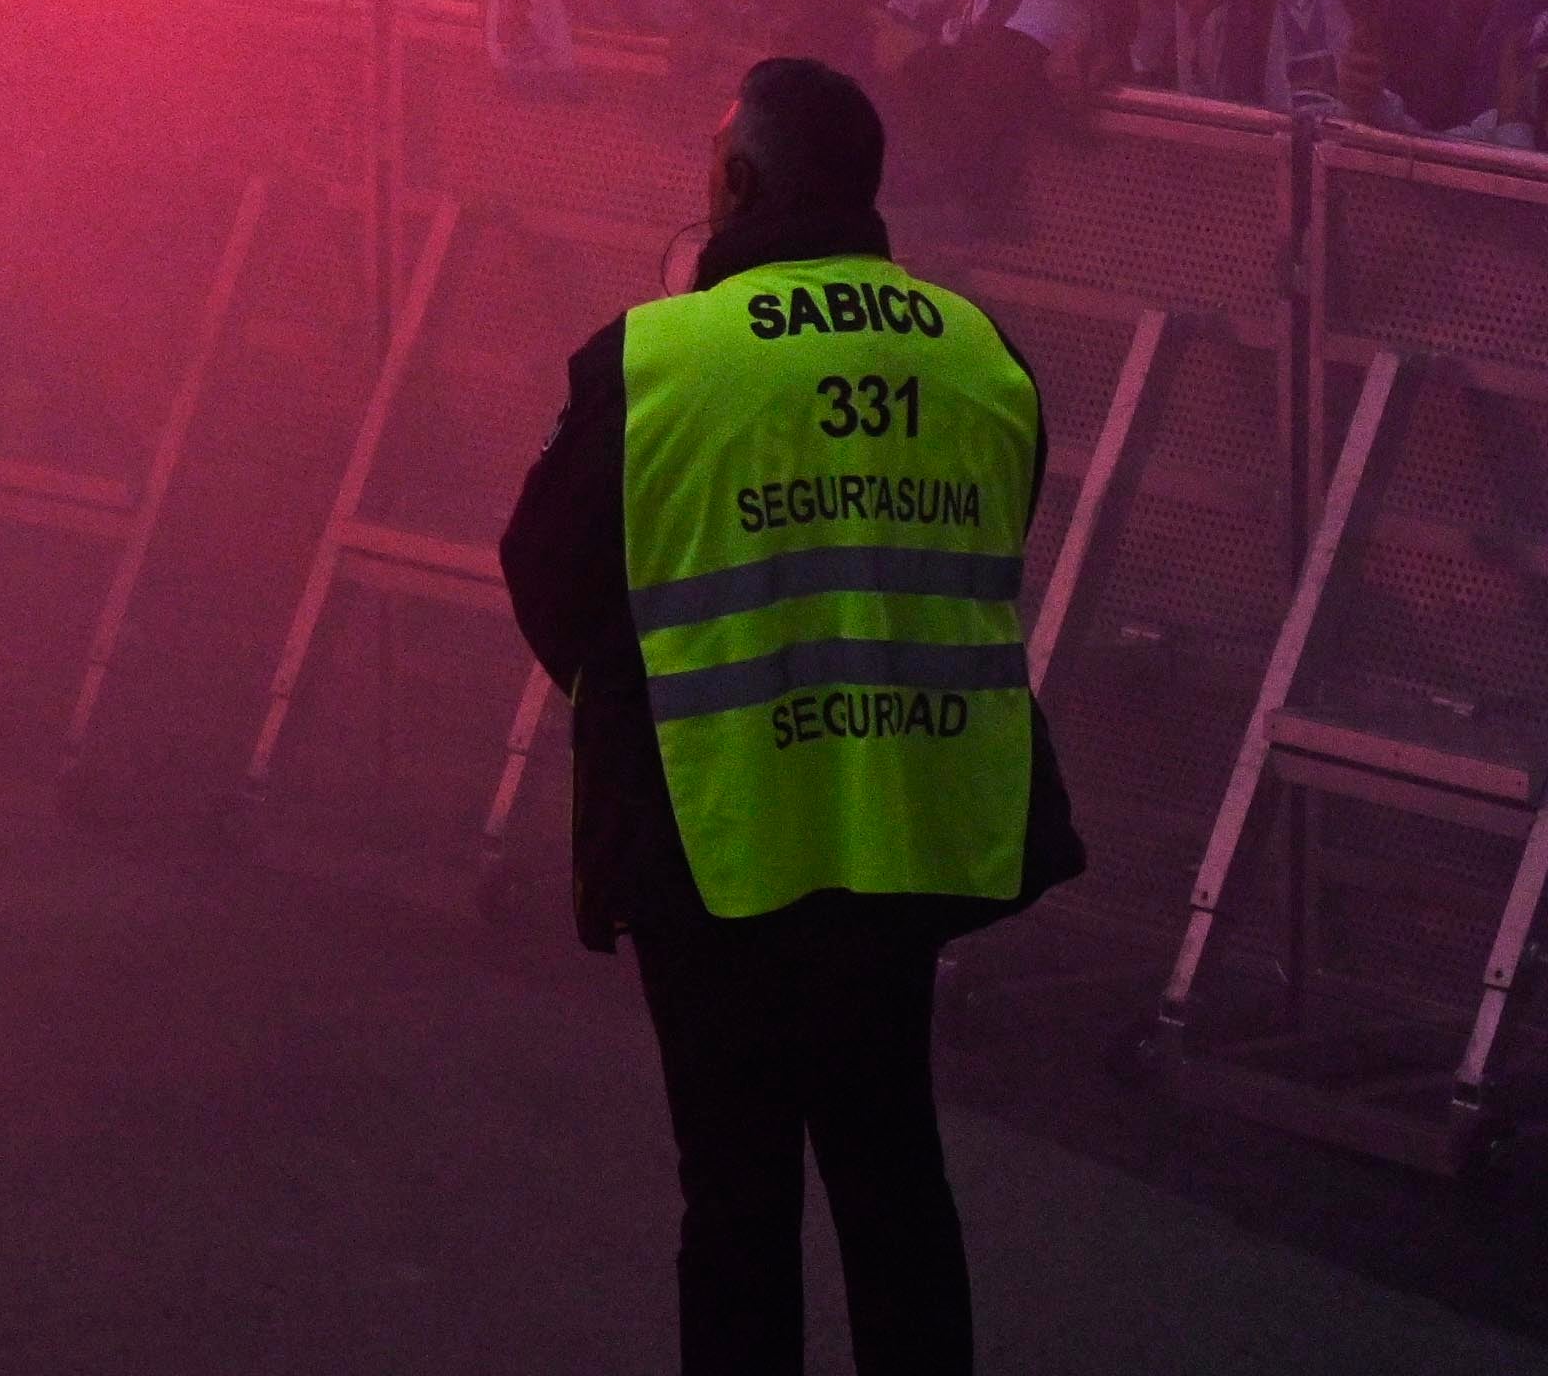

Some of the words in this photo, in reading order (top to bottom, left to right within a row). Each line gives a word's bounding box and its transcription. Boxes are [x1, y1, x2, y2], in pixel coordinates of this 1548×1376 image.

[748, 282, 944, 339] SABICO
[816, 375, 921, 438] 331
[737, 474, 981, 533] SEGURTASUNA
[771, 692, 968, 749] SEGURAD
